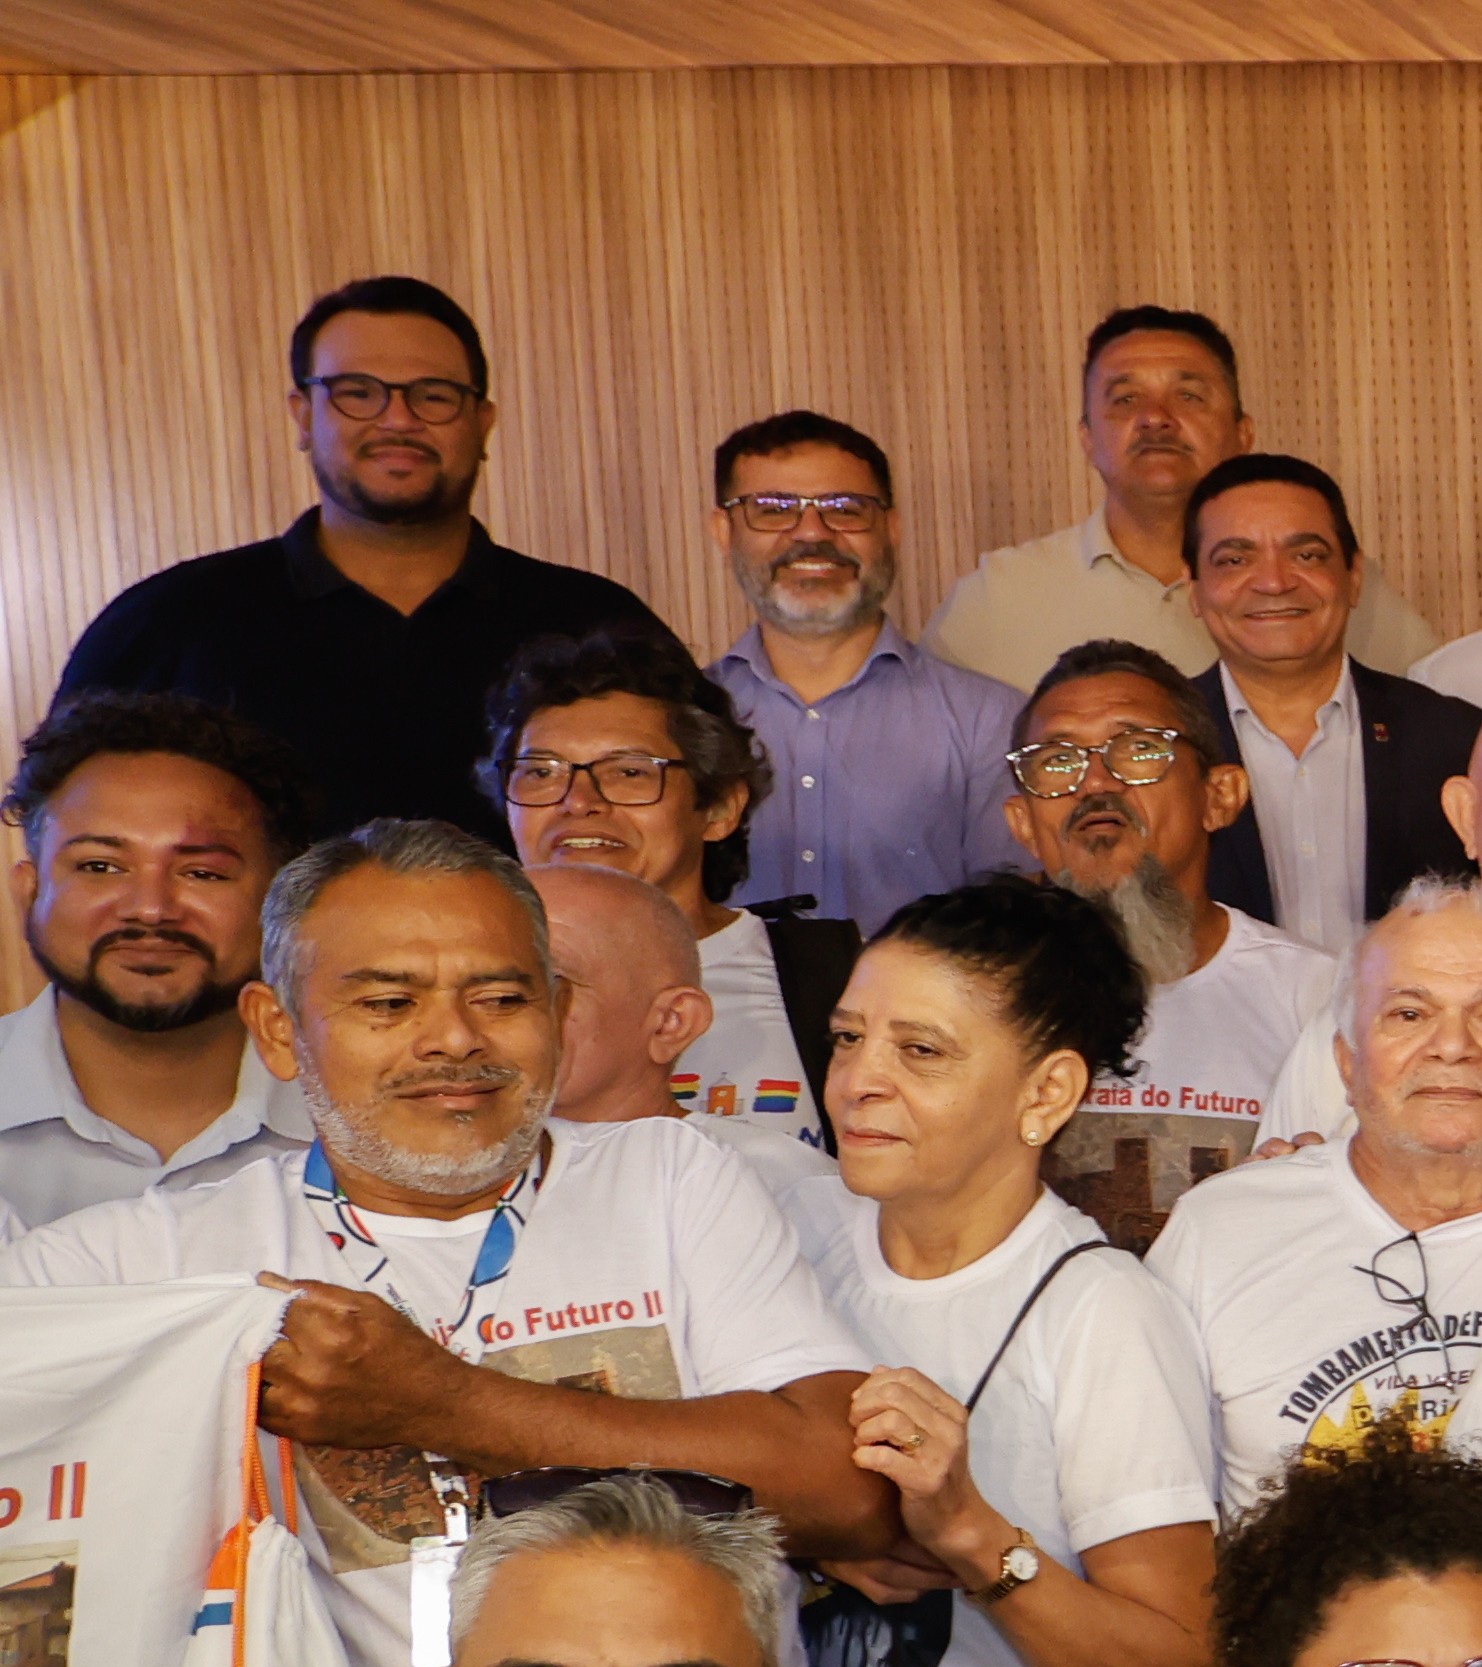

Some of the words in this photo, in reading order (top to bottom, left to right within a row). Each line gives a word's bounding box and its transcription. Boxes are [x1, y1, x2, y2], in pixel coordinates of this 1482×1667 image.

[1141, 1084, 1170, 1107] do
[1179, 1086, 1261, 1115] Futuro
[524, 1299, 634, 1336] Futuro
[1279, 1315, 1437, 1424] TOMBAMENTO
[1374, 1374, 1419, 1391] VILA
